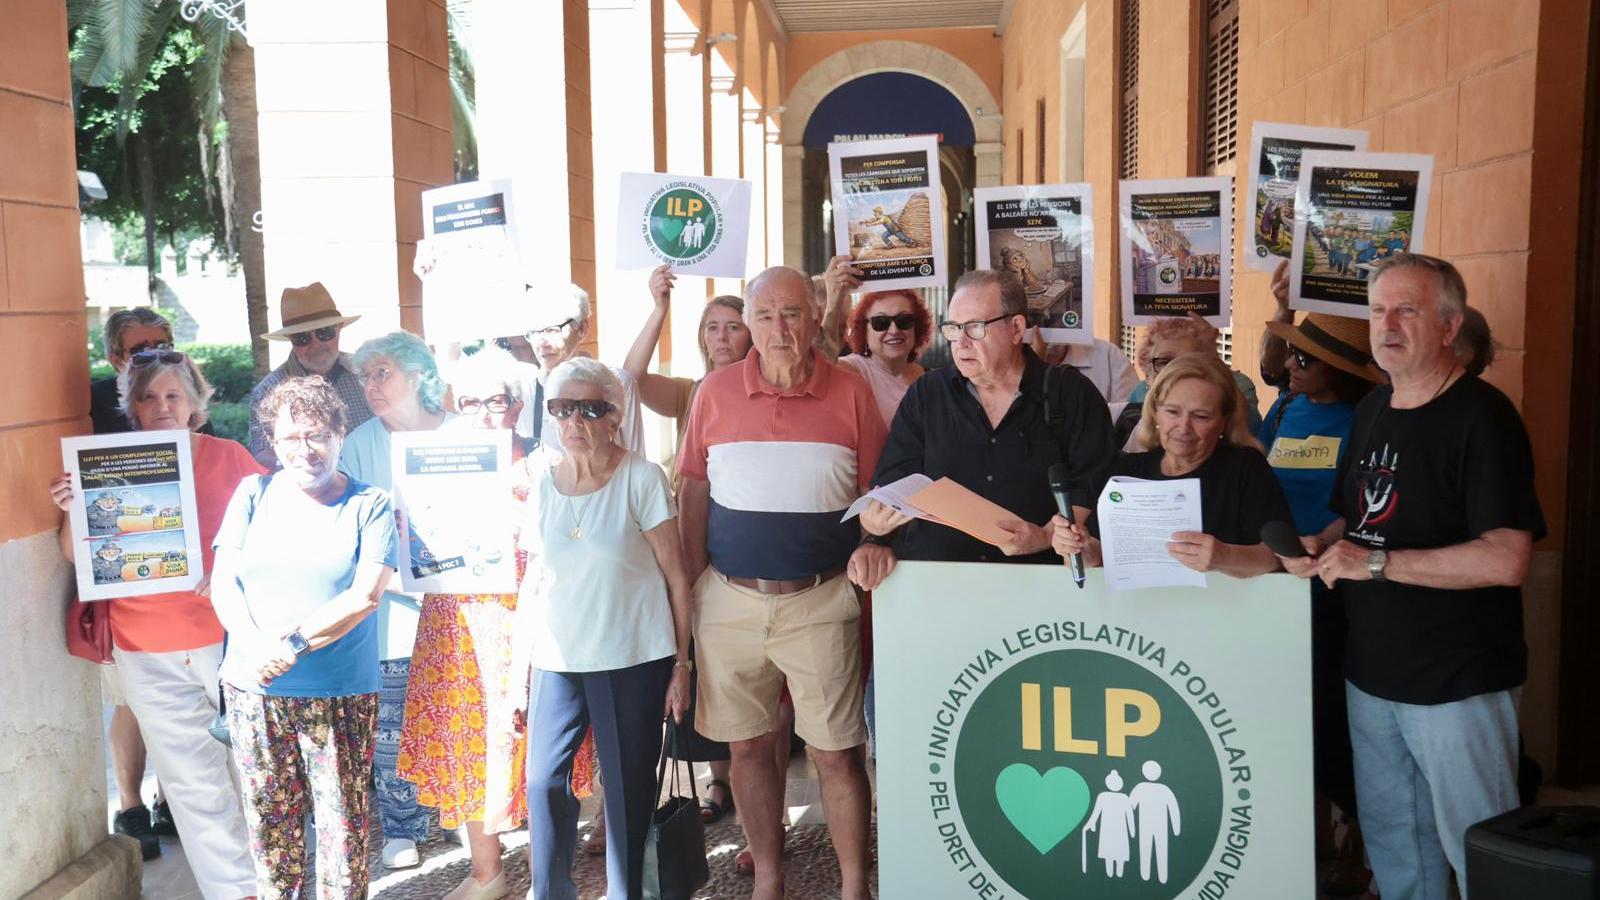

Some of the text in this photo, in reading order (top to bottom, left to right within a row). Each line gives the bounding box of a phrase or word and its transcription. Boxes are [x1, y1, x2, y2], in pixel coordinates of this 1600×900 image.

[643, 182, 724, 222] INICIATIVA LEGISLATIVA POPULAR
[667, 197, 703, 216] ILP
[1349, 171, 1378, 179] VOLEM
[928, 621, 1252, 784] INICIATIVA LEGISLATIVA POPULAR
[1021, 682, 1161, 757] ILP
[928, 781, 998, 900] PEL DRET DE
[1220, 805, 1252, 870] DIGNA
